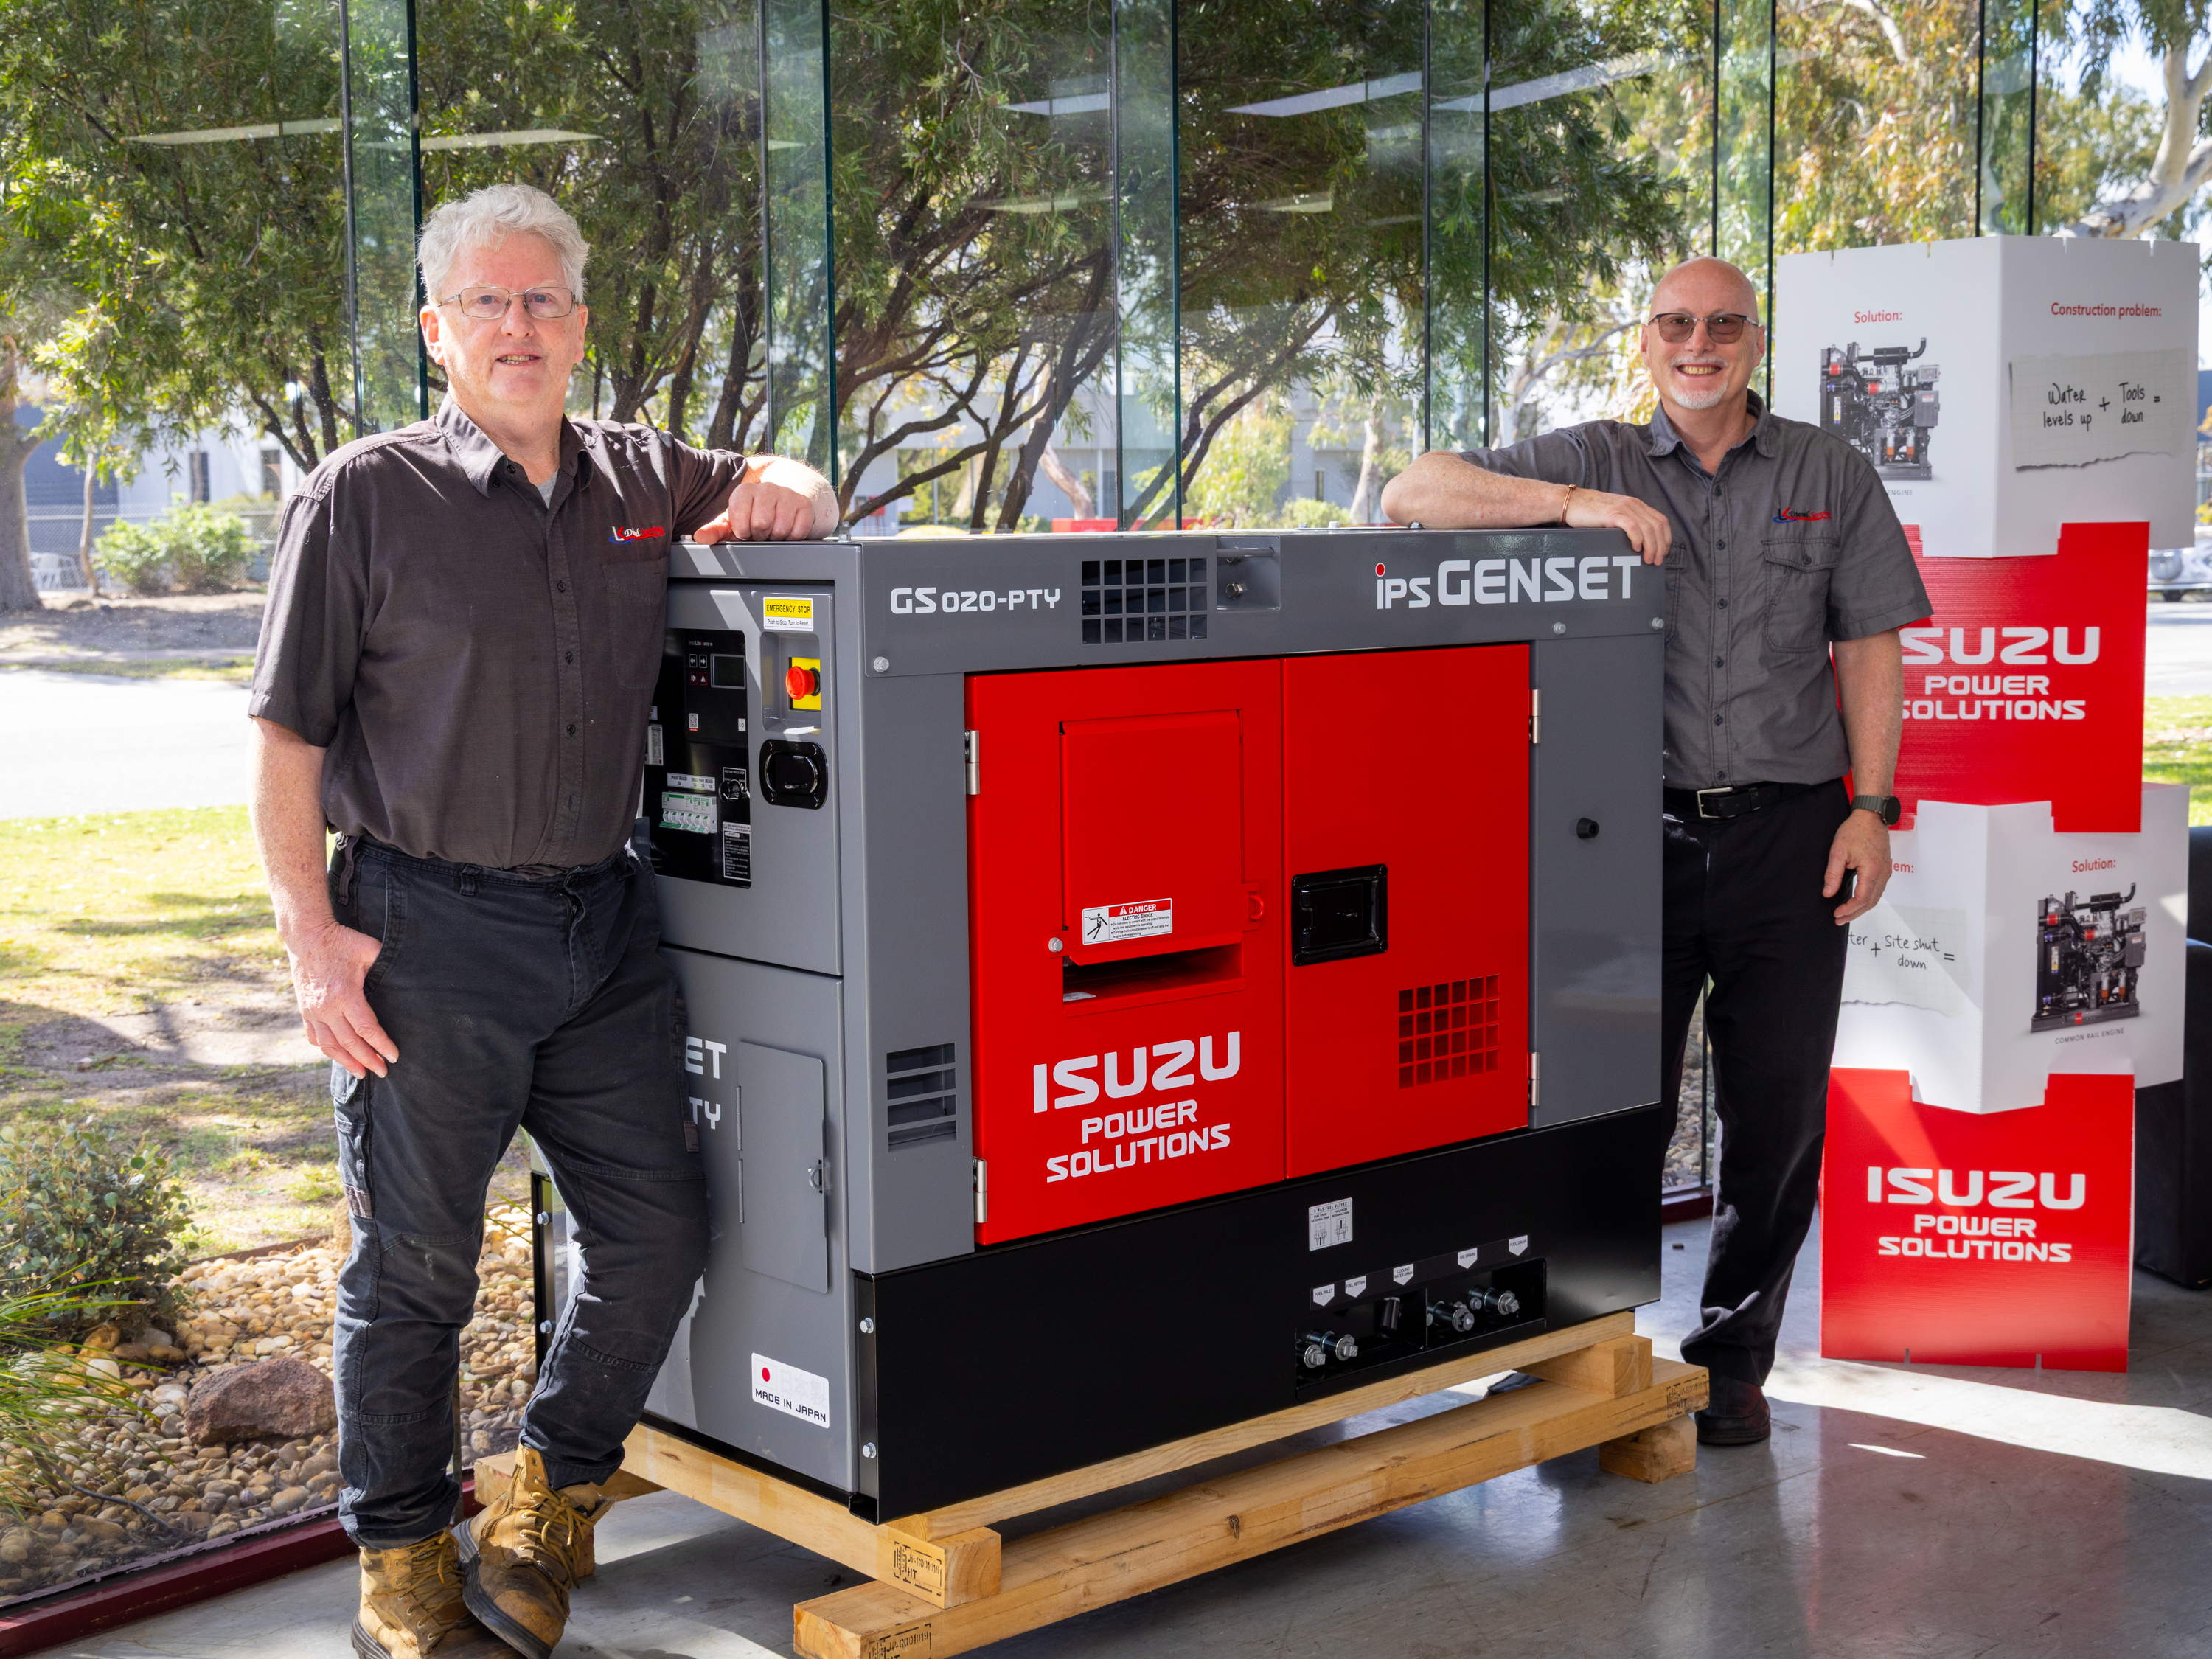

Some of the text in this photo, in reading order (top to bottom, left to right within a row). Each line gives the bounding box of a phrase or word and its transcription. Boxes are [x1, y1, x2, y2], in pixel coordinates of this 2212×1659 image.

[1854, 310, 1903, 324] Solution:
[2051, 302, 2162, 319] Construction problem:
[2048, 383, 2087, 405] Water
[2118, 382, 2145, 403] Tools
[2043, 408, 2144, 432] levels up down
[766, 604, 810, 613] EMERGENCY STOP
[1899, 627, 2100, 664] SUZU
[1925, 675, 2050, 695] POWER
[2072, 858, 2116, 873] Solution:
[1128, 903, 1157, 914] DANGER
[1848, 931, 1868, 945] ter
[1885, 934, 1910, 949] Site
[1913, 937, 1940, 952] shut
[1898, 953, 1927, 970] down
[2054, 1034, 2084, 1045] COMMON
[2101, 1027, 2124, 1037] ENGINE
[1033, 1031, 1240, 1113] ISUZU
[1082, 1099, 1198, 1144] POWER
[1046, 1123, 1231, 1183] SOLUTIONS
[1868, 1166, 2086, 1210] ISUZU
[1914, 1214, 2037, 1238] POWER
[1878, 1236, 2072, 1263] SOLUTIONS
[755, 1388, 826, 1422] MADE IN JAPAN
